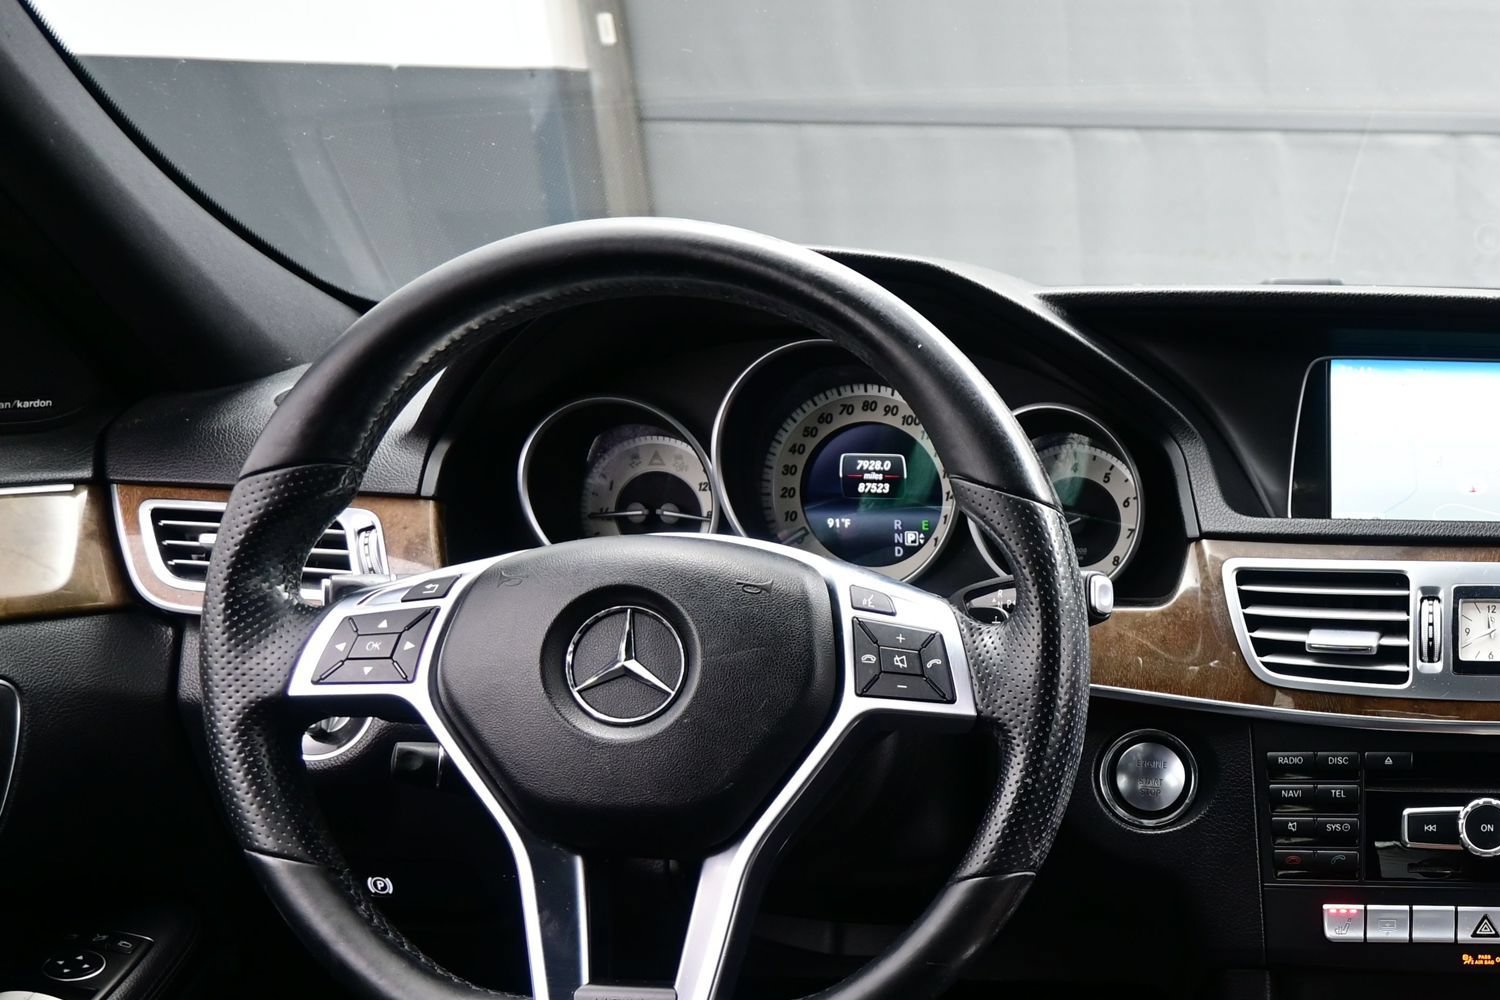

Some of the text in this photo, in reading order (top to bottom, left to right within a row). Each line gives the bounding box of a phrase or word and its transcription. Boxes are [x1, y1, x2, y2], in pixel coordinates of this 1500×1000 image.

[839, 404, 854, 415] 70
[862, 401, 877, 412] 80
[883, 405, 899, 416] 90
[817, 413, 833, 424] 60
[901, 415, 921, 426] 100
[802, 427, 818, 437] 50
[789, 444, 806, 455] 40
[782, 464, 797, 475] 30
[856, 460, 892, 471] 7928.0
[863, 472, 884, 480] miles
[1103, 472, 1111, 483] 5
[780, 487, 796, 498] 20
[857, 483, 890, 493] 87523
[1122, 497, 1131, 508] 6
[784, 511, 798, 521] 10
[827, 518, 851, 528] 91°F
[894, 520, 901, 530] R
[922, 520, 929, 530] E
[894, 533, 903, 543] N
[907, 533, 916, 544] P
[1127, 528, 1135, 539] 7
[895, 547, 903, 557] D
[1112, 555, 1120, 566] 8
[1487, 605, 1497, 613] 12
[1465, 627, 1471, 636] 9
[366, 641, 382, 651] OK
[1488, 651, 1494, 660] 6
[1278, 756, 1304, 765] RADIO
[1328, 757, 1349, 765] DISC
[1281, 790, 1302, 798] NAVI
[1331, 790, 1347, 798] TEL
[1326, 824, 1341, 832] SYS
[1480, 819, 1494, 832] ON
